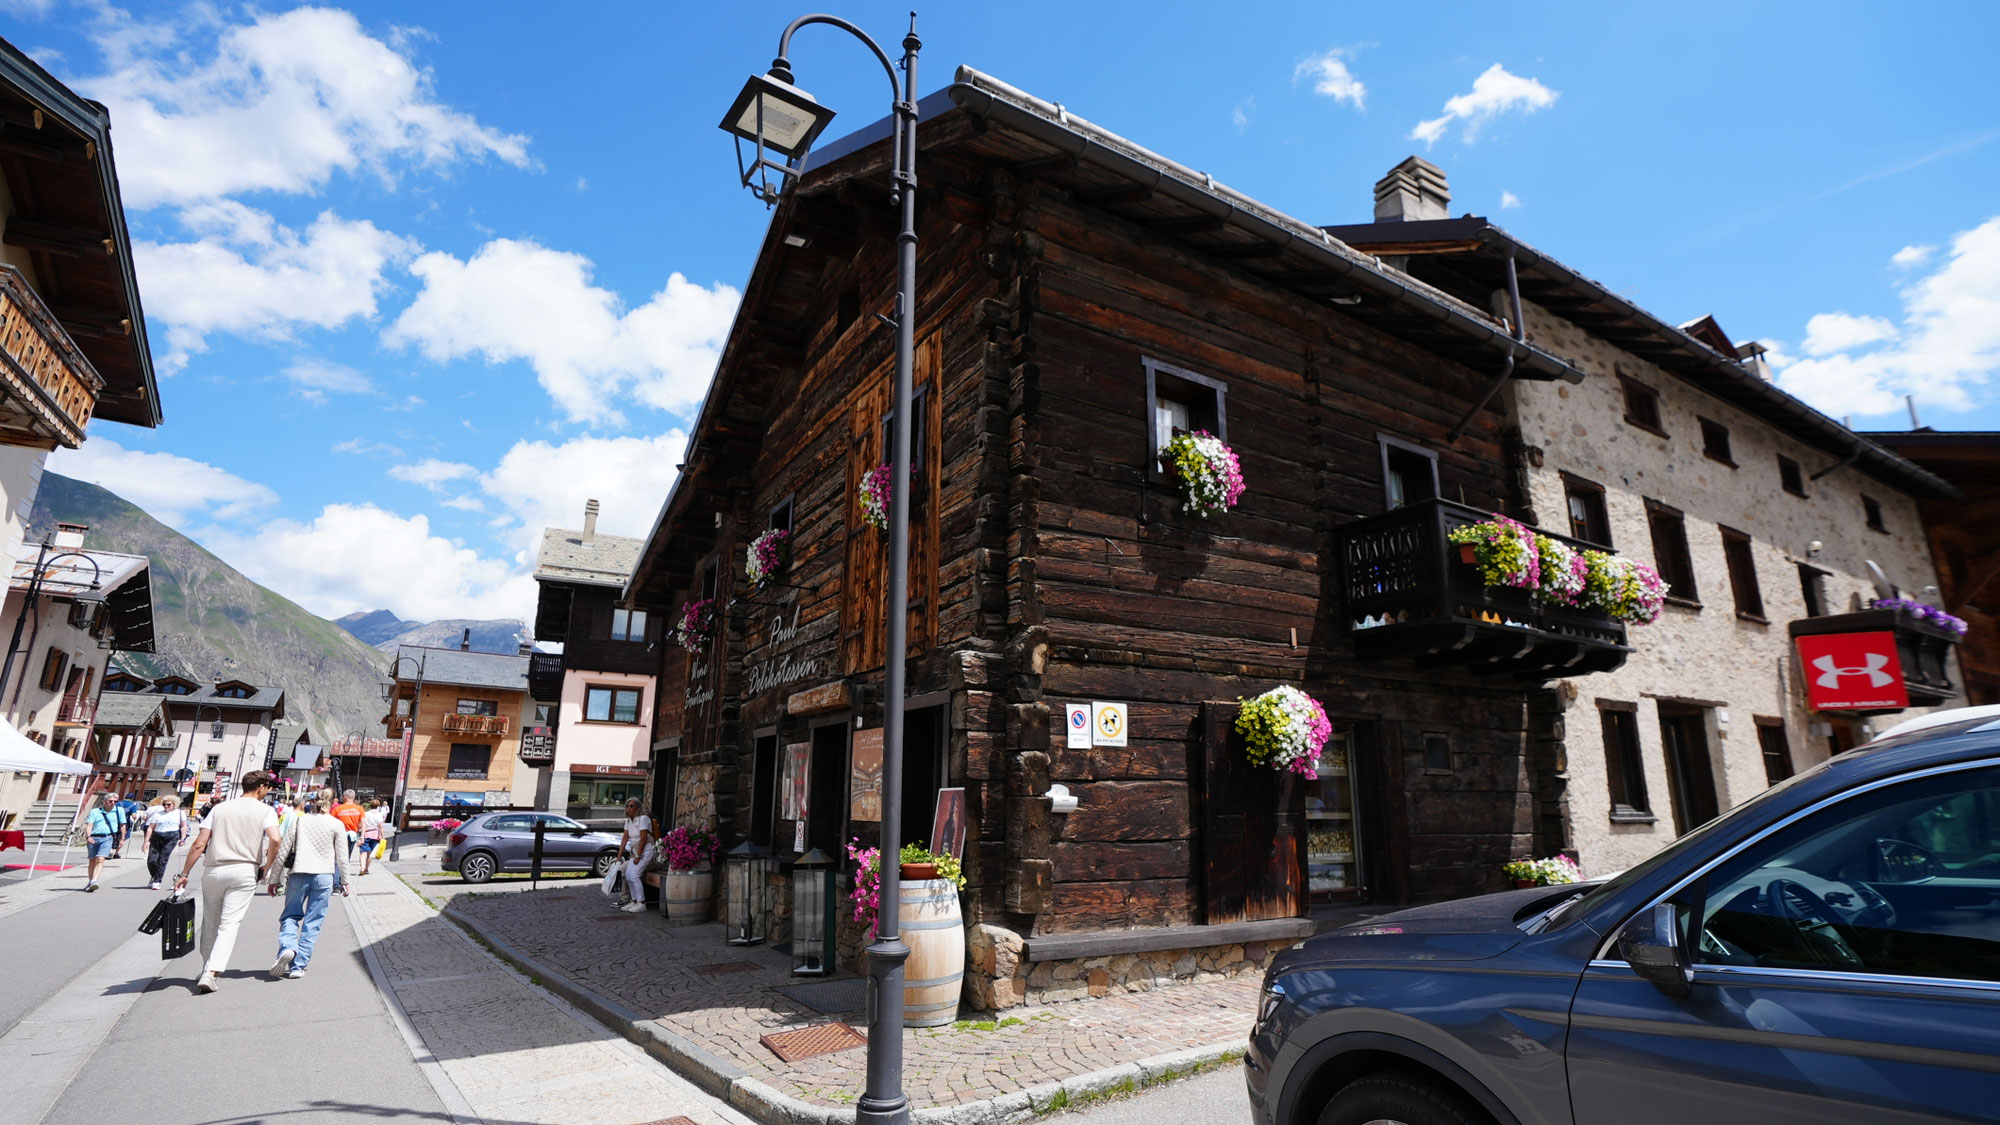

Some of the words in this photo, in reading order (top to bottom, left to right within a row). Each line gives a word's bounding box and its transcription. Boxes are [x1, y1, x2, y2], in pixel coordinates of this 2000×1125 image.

[769, 605, 800, 649] Paul
[748, 654, 818, 694] Delikatessen
[684, 684, 715, 718] Boutique
